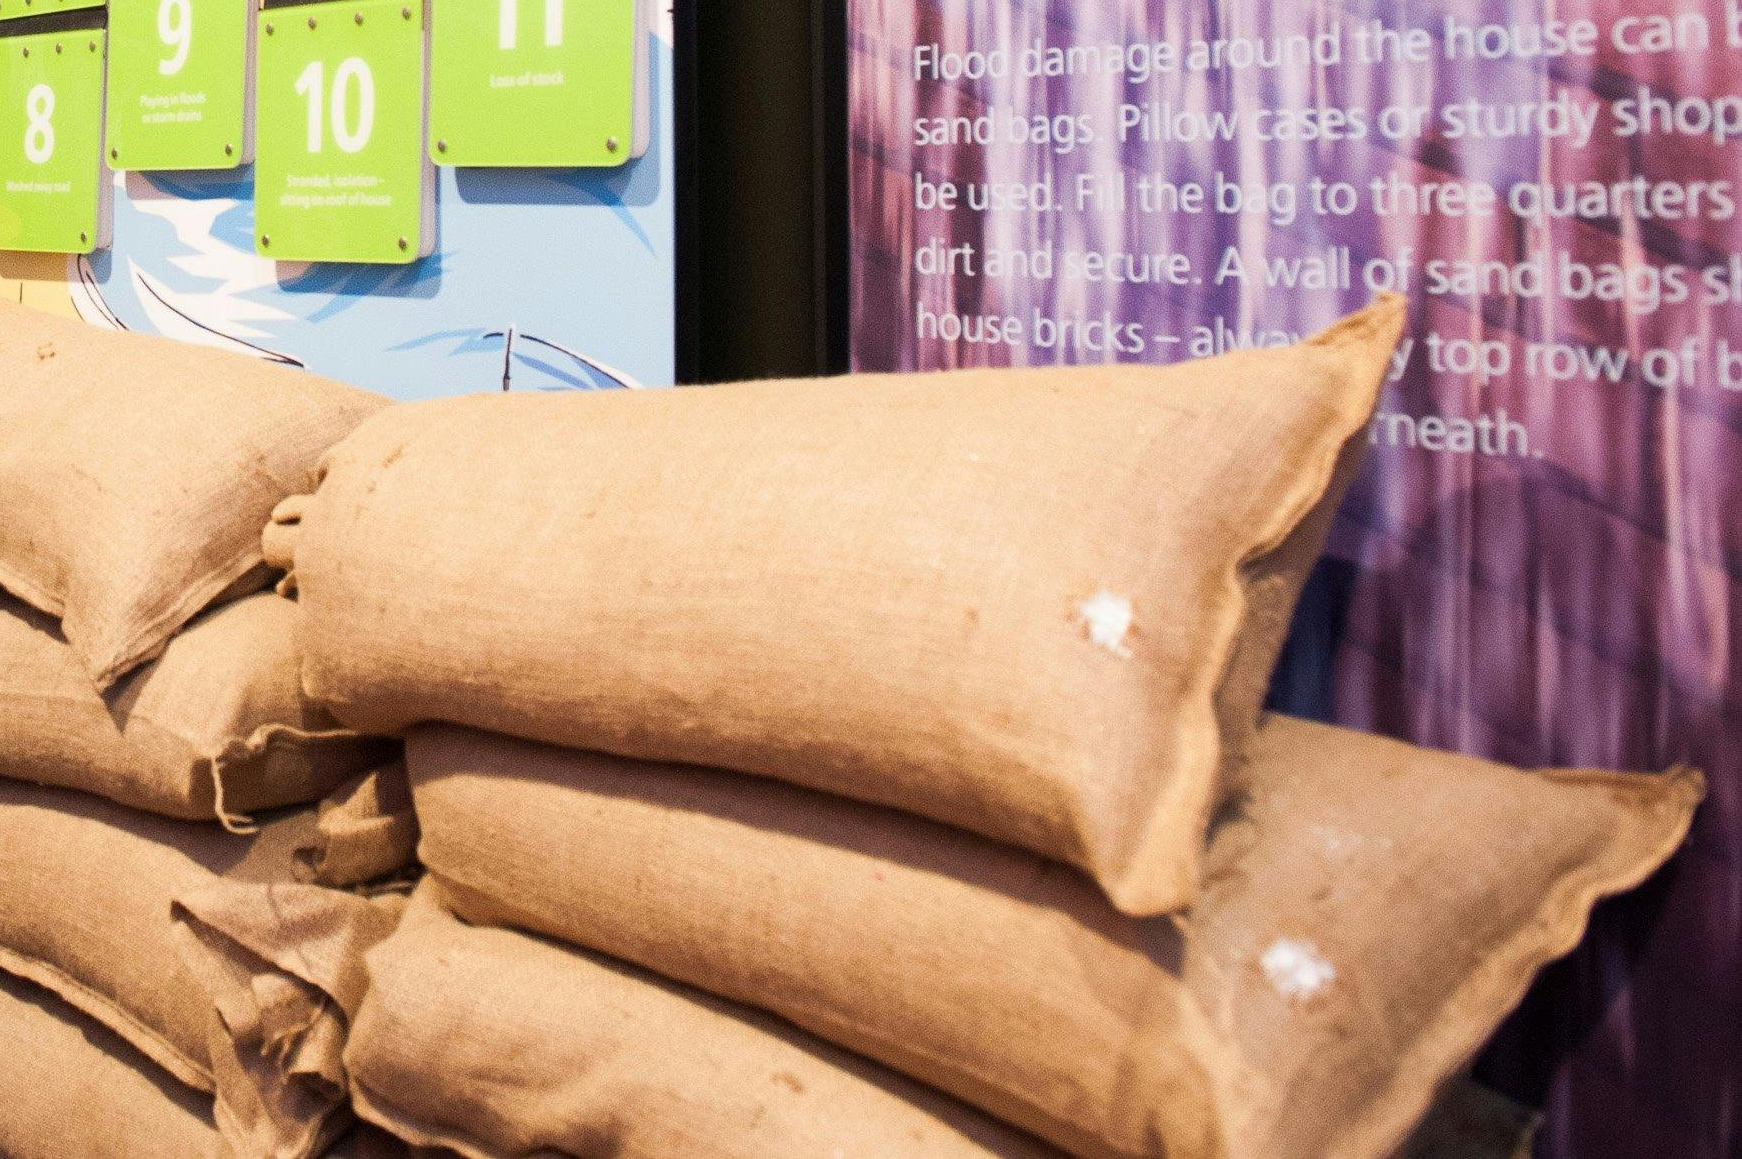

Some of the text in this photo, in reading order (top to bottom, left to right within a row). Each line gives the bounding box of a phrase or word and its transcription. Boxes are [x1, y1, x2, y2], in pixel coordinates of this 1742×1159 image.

[517, 71, 531, 86] of
[914, 41, 1007, 81] Flood
[1021, 39, 1174, 84] damage
[1186, 19, 1340, 73] around
[1359, 18, 1432, 63] the
[1445, 18, 1597, 60] house
[1612, 13, 1708, 55] can
[24, 84, 55, 164] 8
[294, 57, 375, 153] 10
[914, 87, 1742, 154] sand bags. Pillow cases or sturdy shop
[914, 171, 1735, 228] be used. Fill the bag to three quarters
[915, 236, 975, 276] dirt
[985, 241, 1052, 279] and
[1065, 252, 1201, 285] secure.
[1216, 246, 1250, 285] A
[1265, 246, 1349, 289] wall
[1362, 246, 1414, 294] of
[1425, 252, 1543, 297] sand
[1559, 252, 1689, 314] bags
[917, 303, 1023, 342] house
[1034, 308, 1144, 353] bricks
[1427, 332, 1511, 383] top
[1525, 342, 1629, 382] row
[1642, 338, 1695, 388] of
